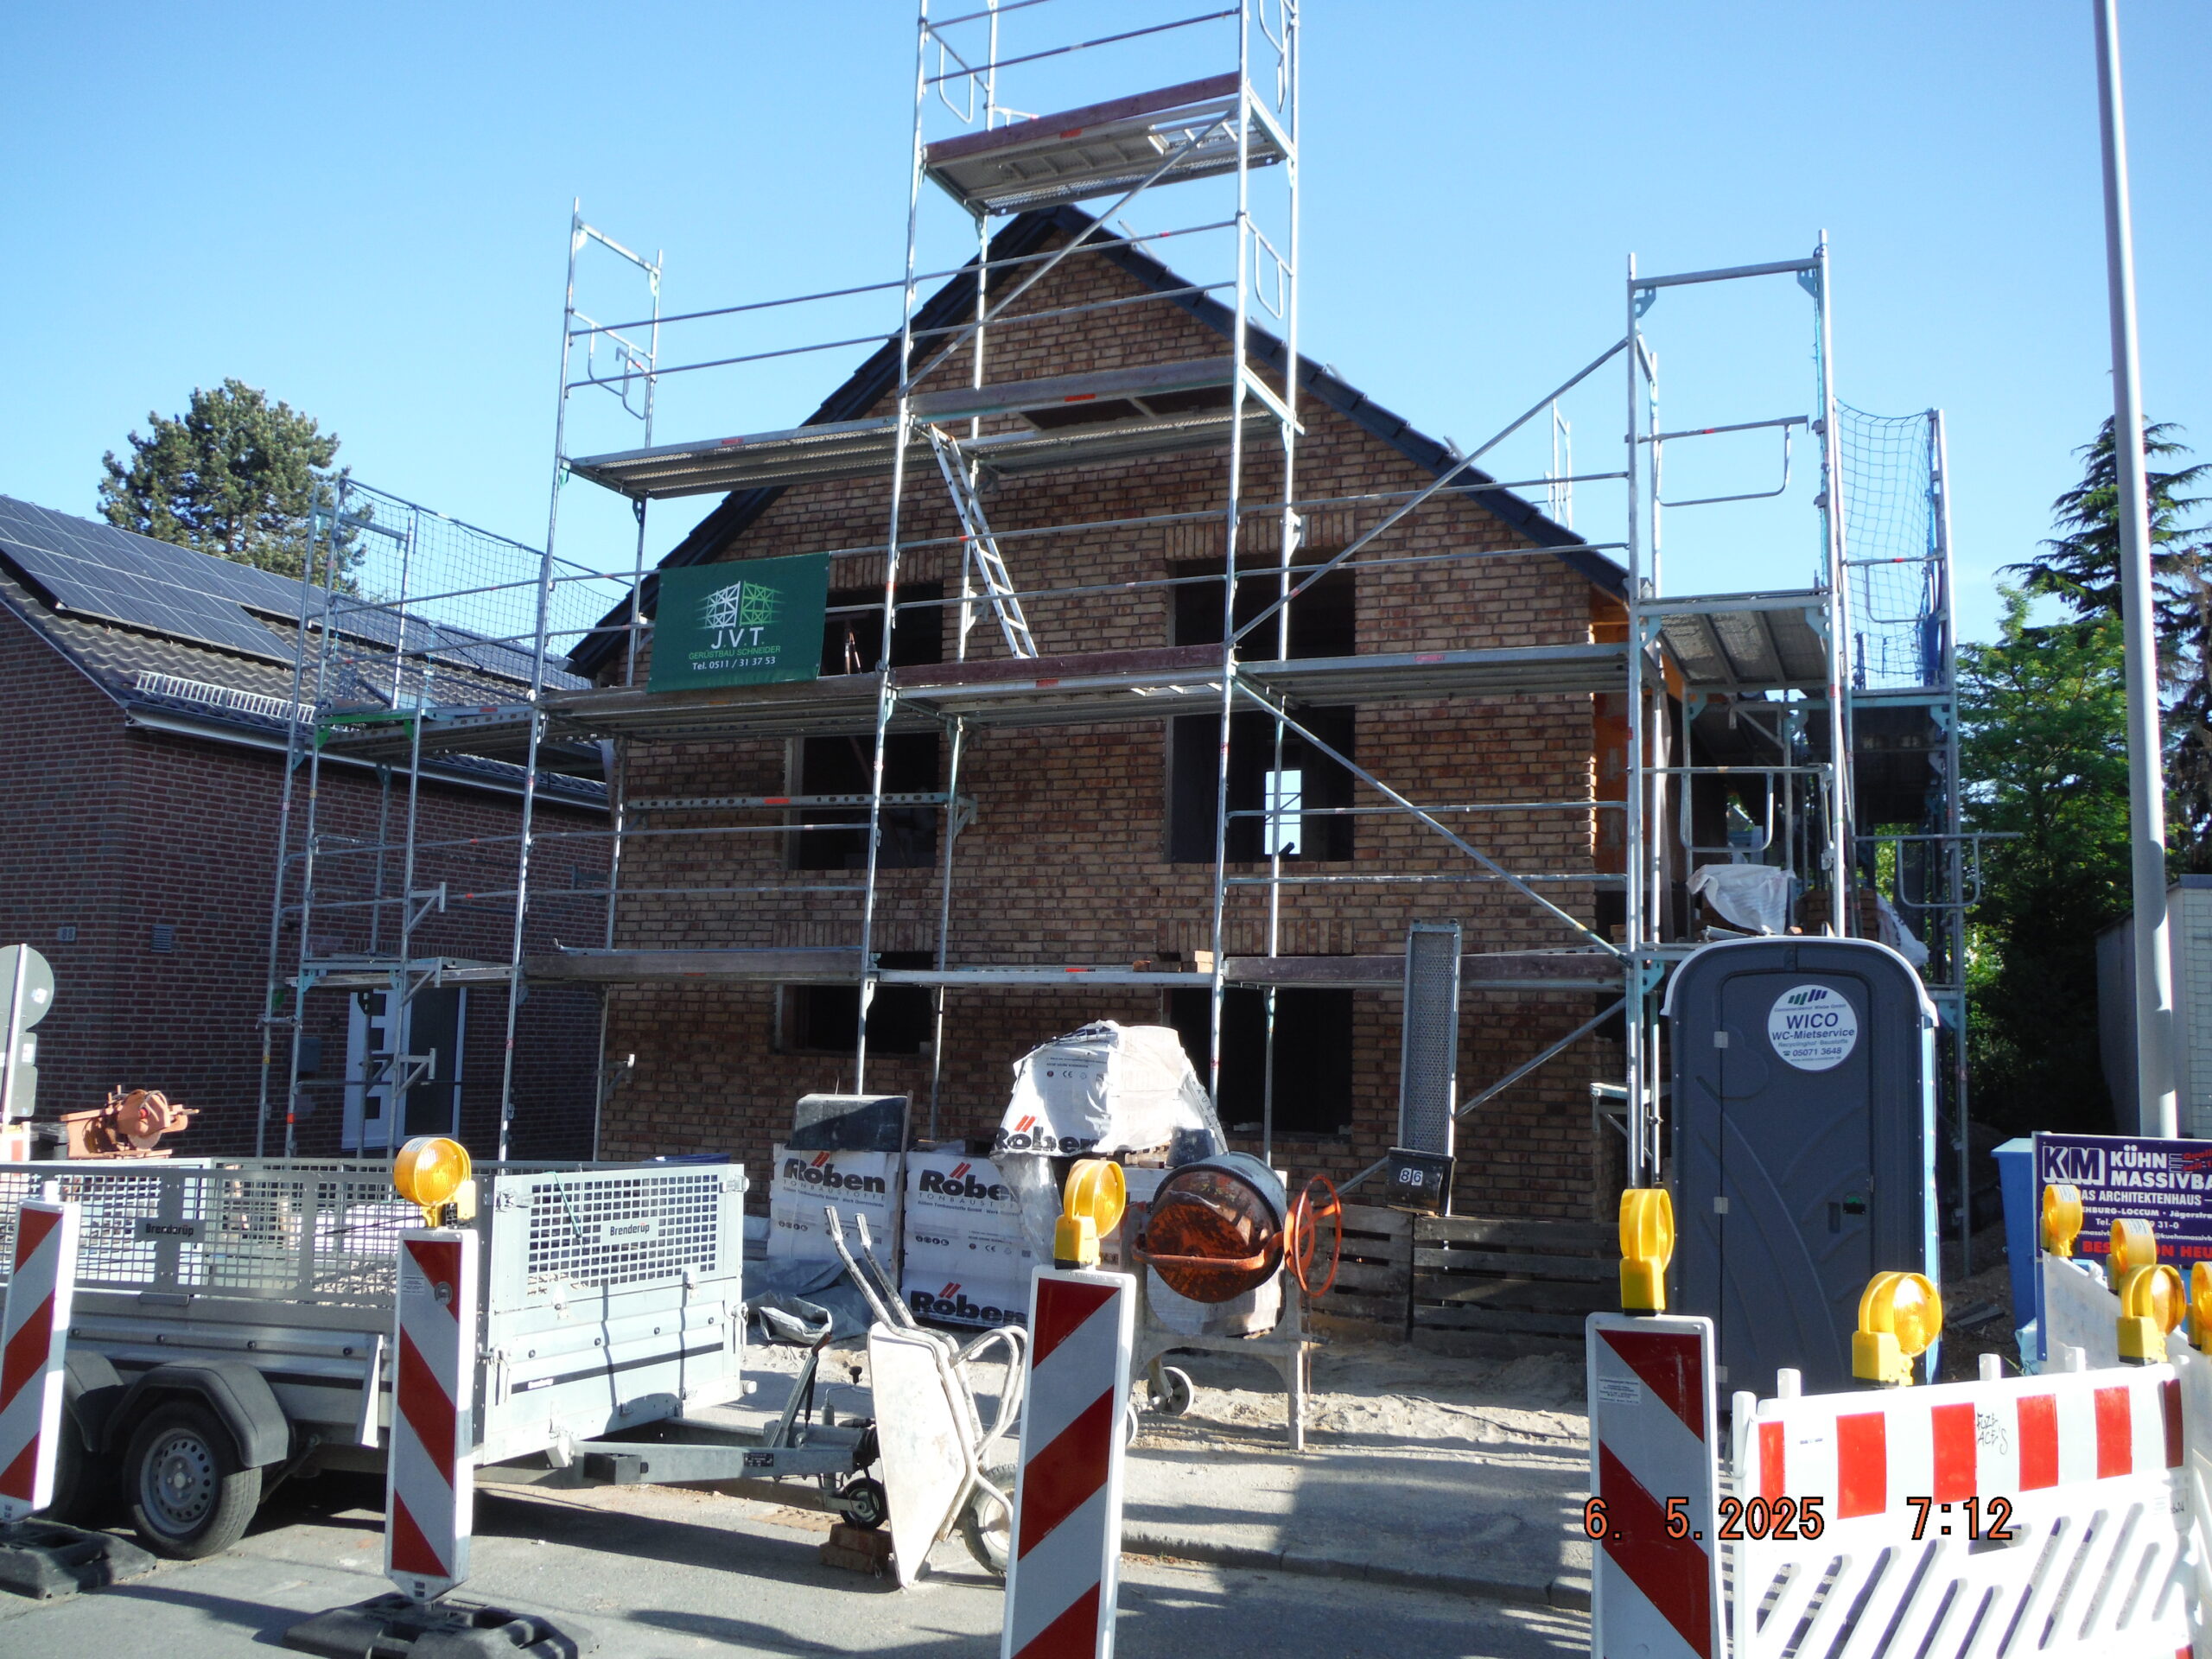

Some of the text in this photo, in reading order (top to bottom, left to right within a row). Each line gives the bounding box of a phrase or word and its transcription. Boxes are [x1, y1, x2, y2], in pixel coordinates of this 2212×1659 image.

[689, 645, 781, 660] GERÜSTBAU SCHNEIDER
[692, 662, 708, 671] Tel.
[709, 659, 729, 670] 0511
[739, 658, 749, 667] 31
[752, 657, 763, 665] 37
[765, 656, 776, 664] 53
[1786, 1012, 1839, 1030] WICO
[1772, 1027, 1855, 1041] WC-Mietservice
[1793, 1048, 1818, 1057] 05071
[2110, 1144, 2168, 1169] KÜHN
[784, 1151, 886, 1193] Röben
[2043, 1146, 2106, 1186] KM
[1400, 1169, 1422, 1184] 86
[2099, 1190, 2202, 1207] ARCHITEKTENHAUS
[2157, 1220, 2179, 1230] 31-0
[2082, 1240, 2111, 1253] BES
[910, 1281, 1027, 1325] Röben
